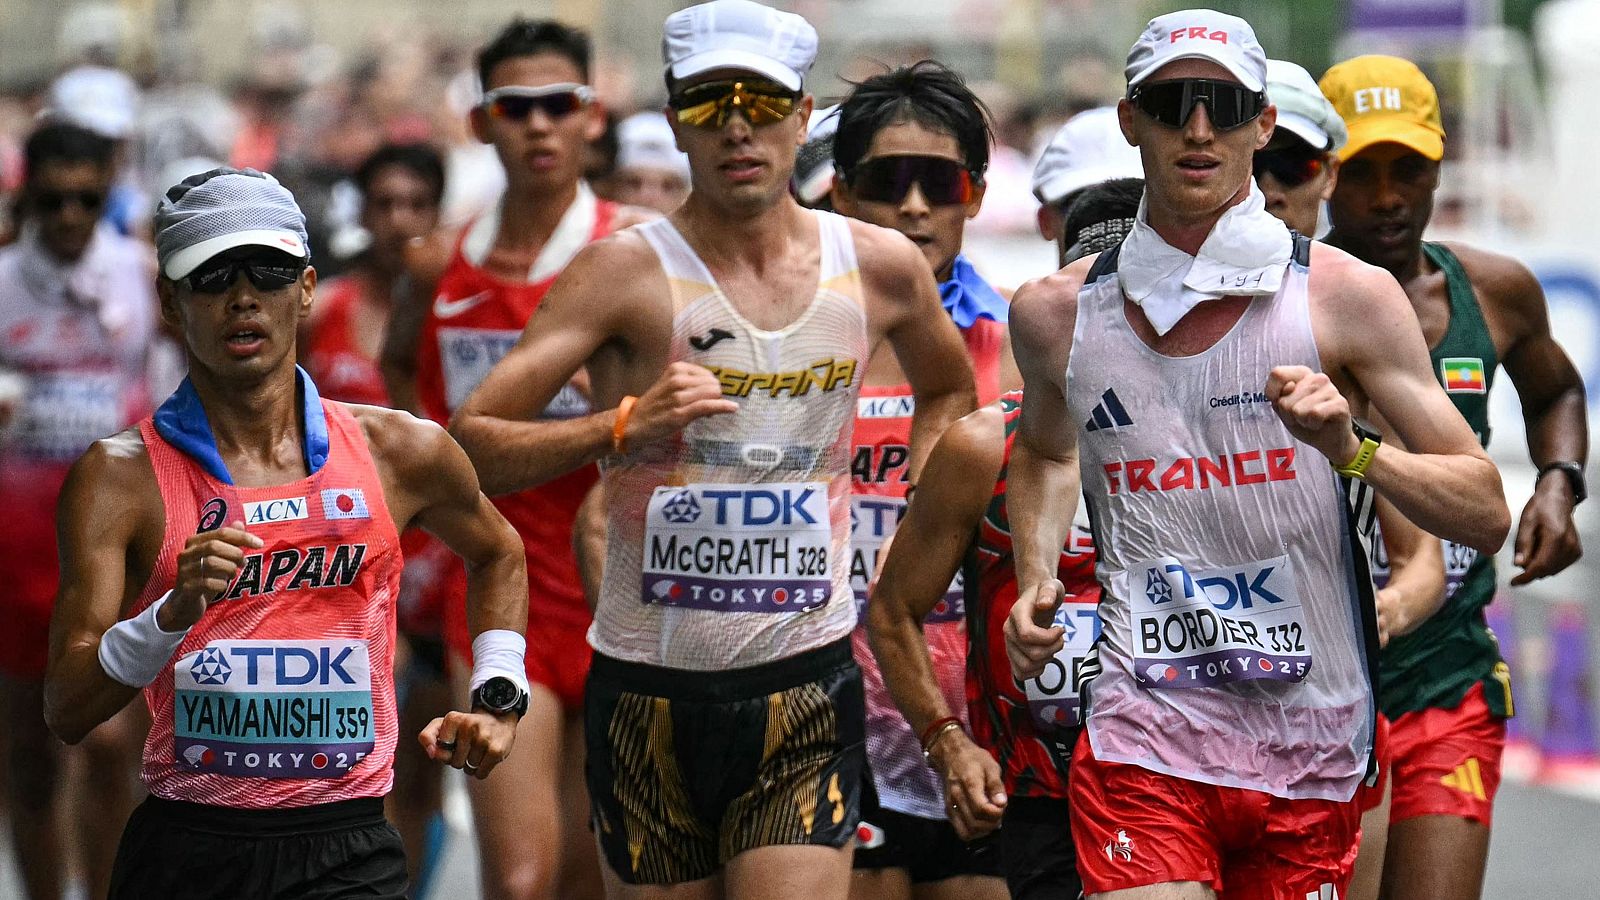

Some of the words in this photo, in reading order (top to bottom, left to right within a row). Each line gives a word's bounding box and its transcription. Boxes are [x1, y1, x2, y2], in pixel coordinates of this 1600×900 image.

[1170, 27, 1228, 45] FRA
[1353, 86, 1401, 113] ETH
[861, 397, 911, 417] ACN
[1209, 394, 1240, 408] Crédit
[1103, 447, 1296, 495] FRANCE
[249, 499, 303, 522] ACN
[702, 489, 818, 526] TDK
[212, 544, 367, 602] APAN
[651, 535, 789, 575] McGRATH
[796, 547, 828, 576] 328
[1165, 564, 1285, 611] TDK
[1140, 608, 1265, 654] BORDIER
[1266, 622, 1306, 652] 332
[231, 647, 357, 686] TDK
[181, 695, 330, 738] YAMANISHI
[335, 707, 369, 739] 359
